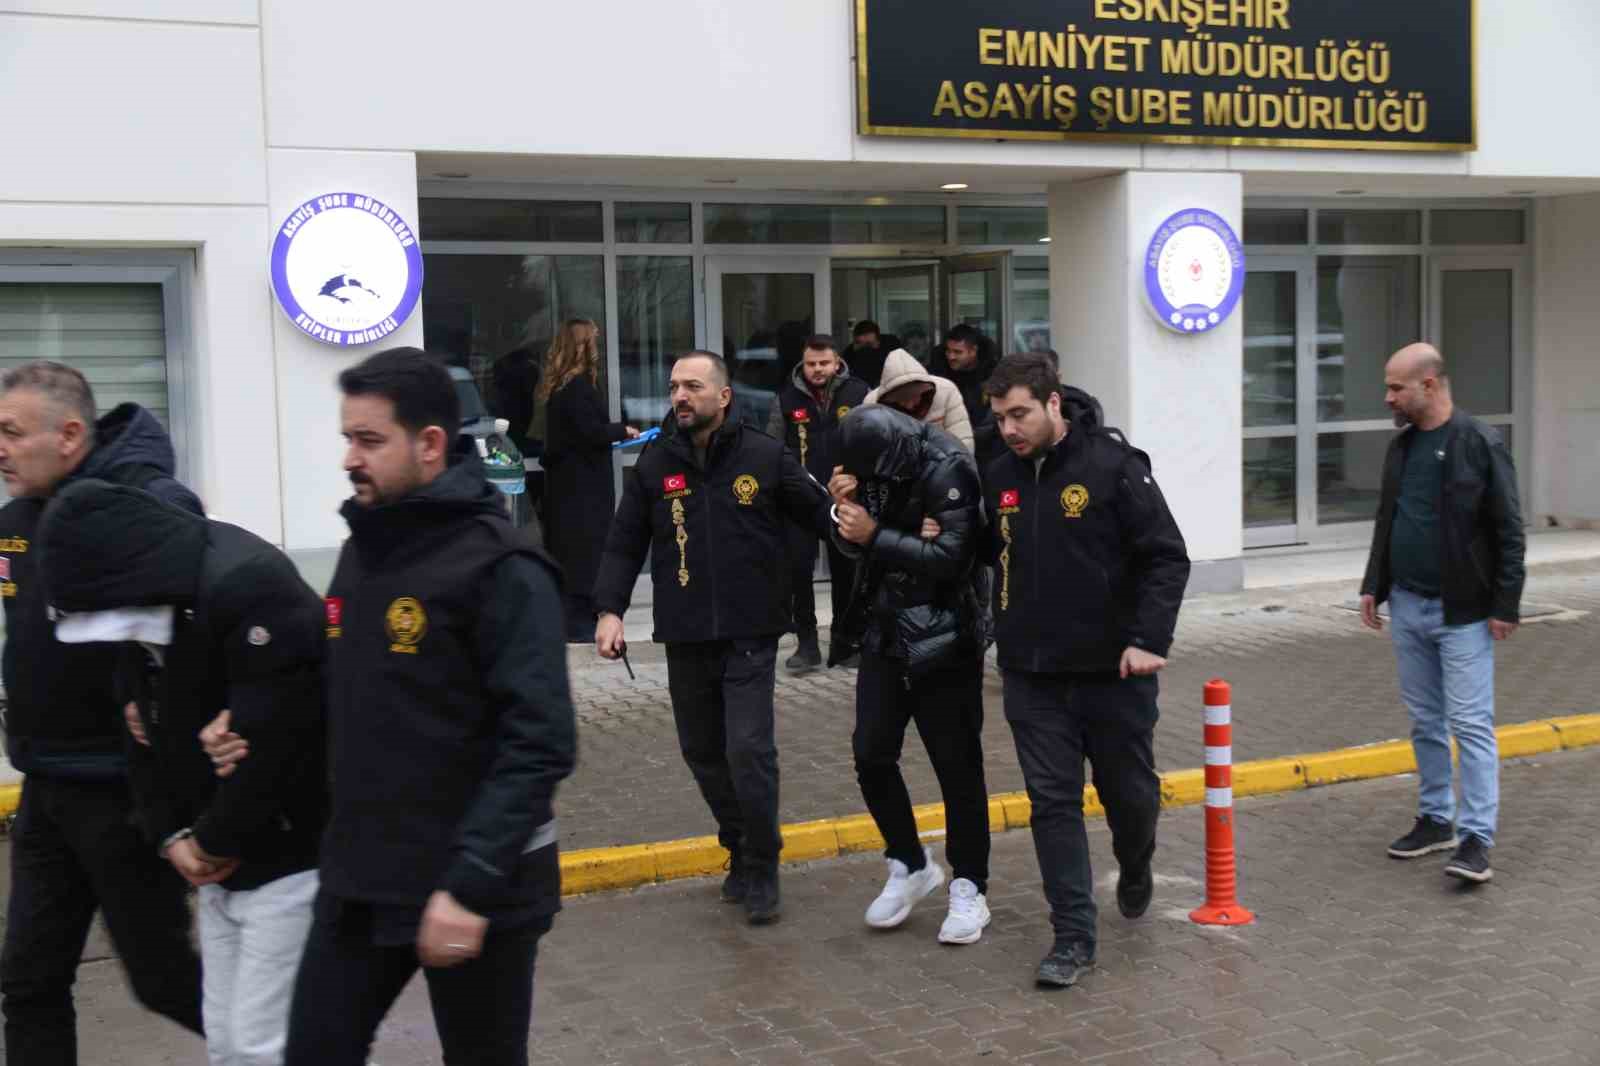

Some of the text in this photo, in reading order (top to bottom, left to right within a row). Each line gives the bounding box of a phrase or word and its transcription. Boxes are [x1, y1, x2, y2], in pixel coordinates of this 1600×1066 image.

[978, 24, 1391, 84] EMNİYET MÜDÜRLÜĞÜ
[932, 75, 1428, 133] ASAYİŞ ŞUBE MÜDÜRLÜĞÜ
